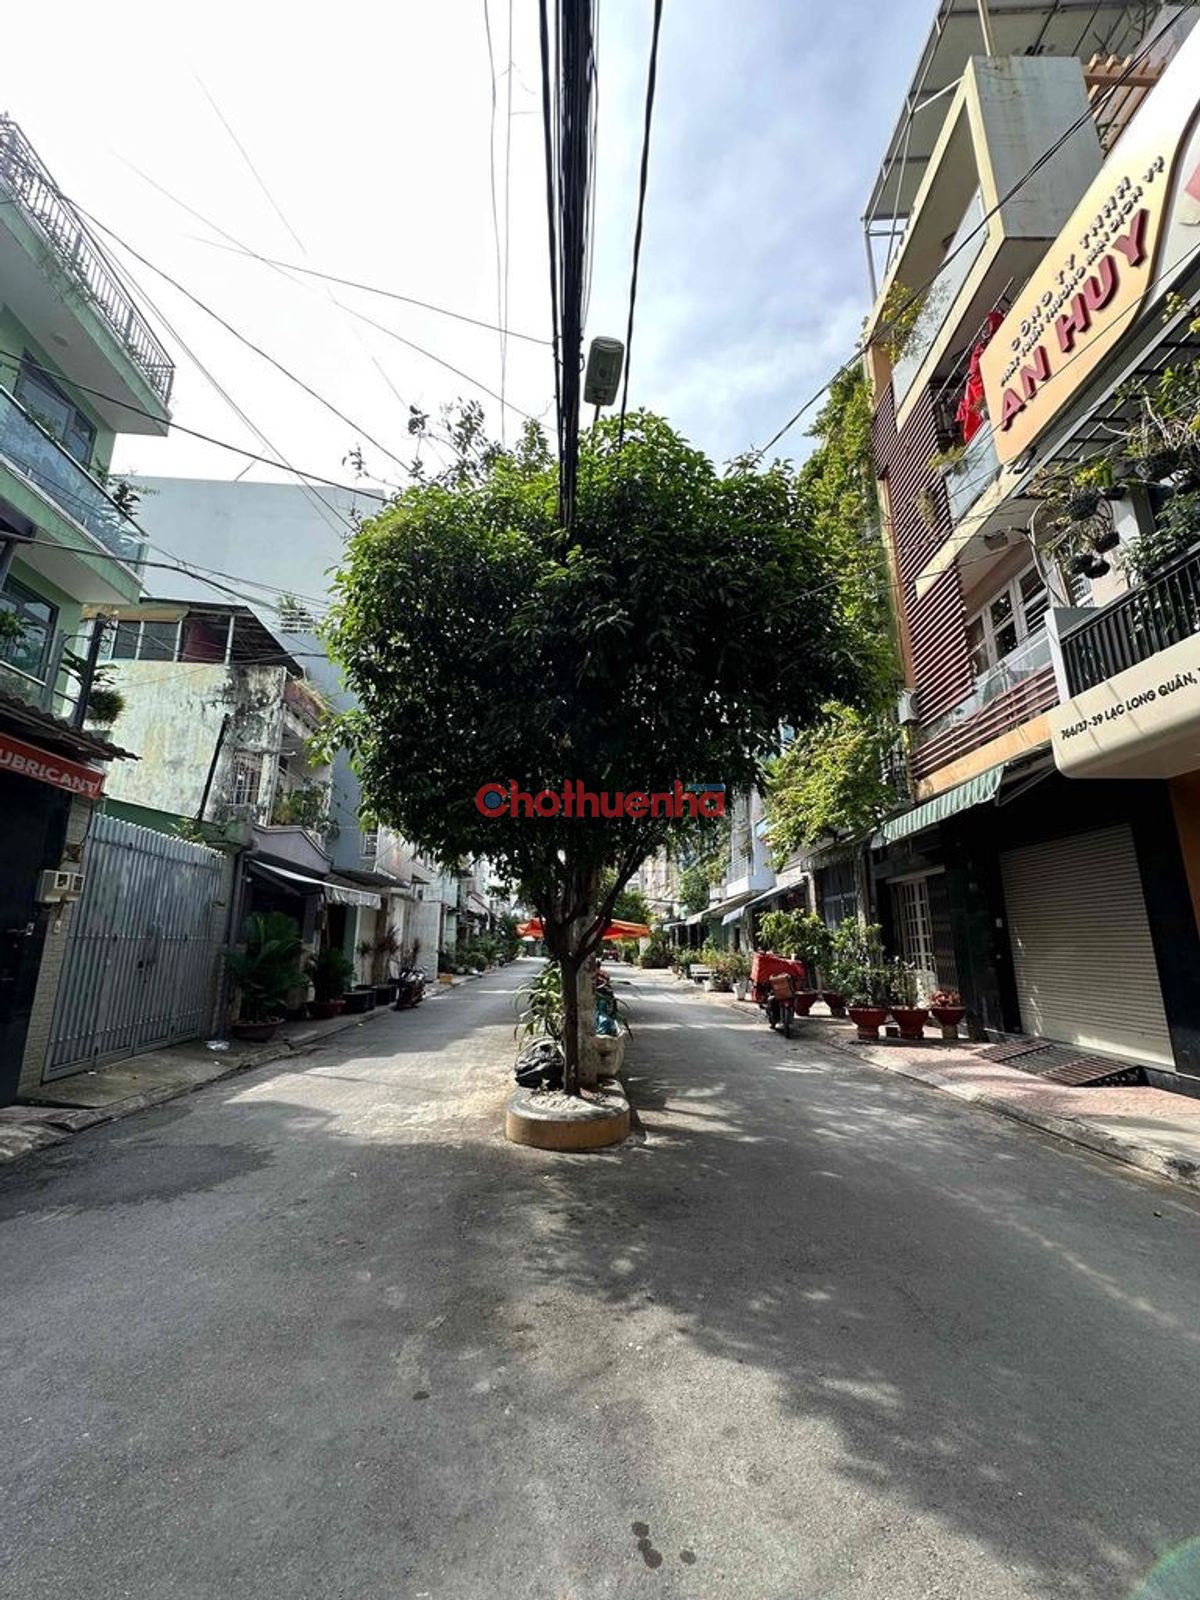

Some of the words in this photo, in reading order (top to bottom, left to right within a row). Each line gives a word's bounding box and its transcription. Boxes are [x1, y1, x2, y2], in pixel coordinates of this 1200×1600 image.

[1001, 345, 1052, 432] AN
[1054, 207, 1150, 353] HUY
[1011, 290, 1053, 352] CÔNG
[1055, 253, 1076, 285] TY
[1080, 175, 1131, 250] TNHH
[1104, 703, 1125, 721] LẠC
[1125, 689, 1156, 711] LONG
